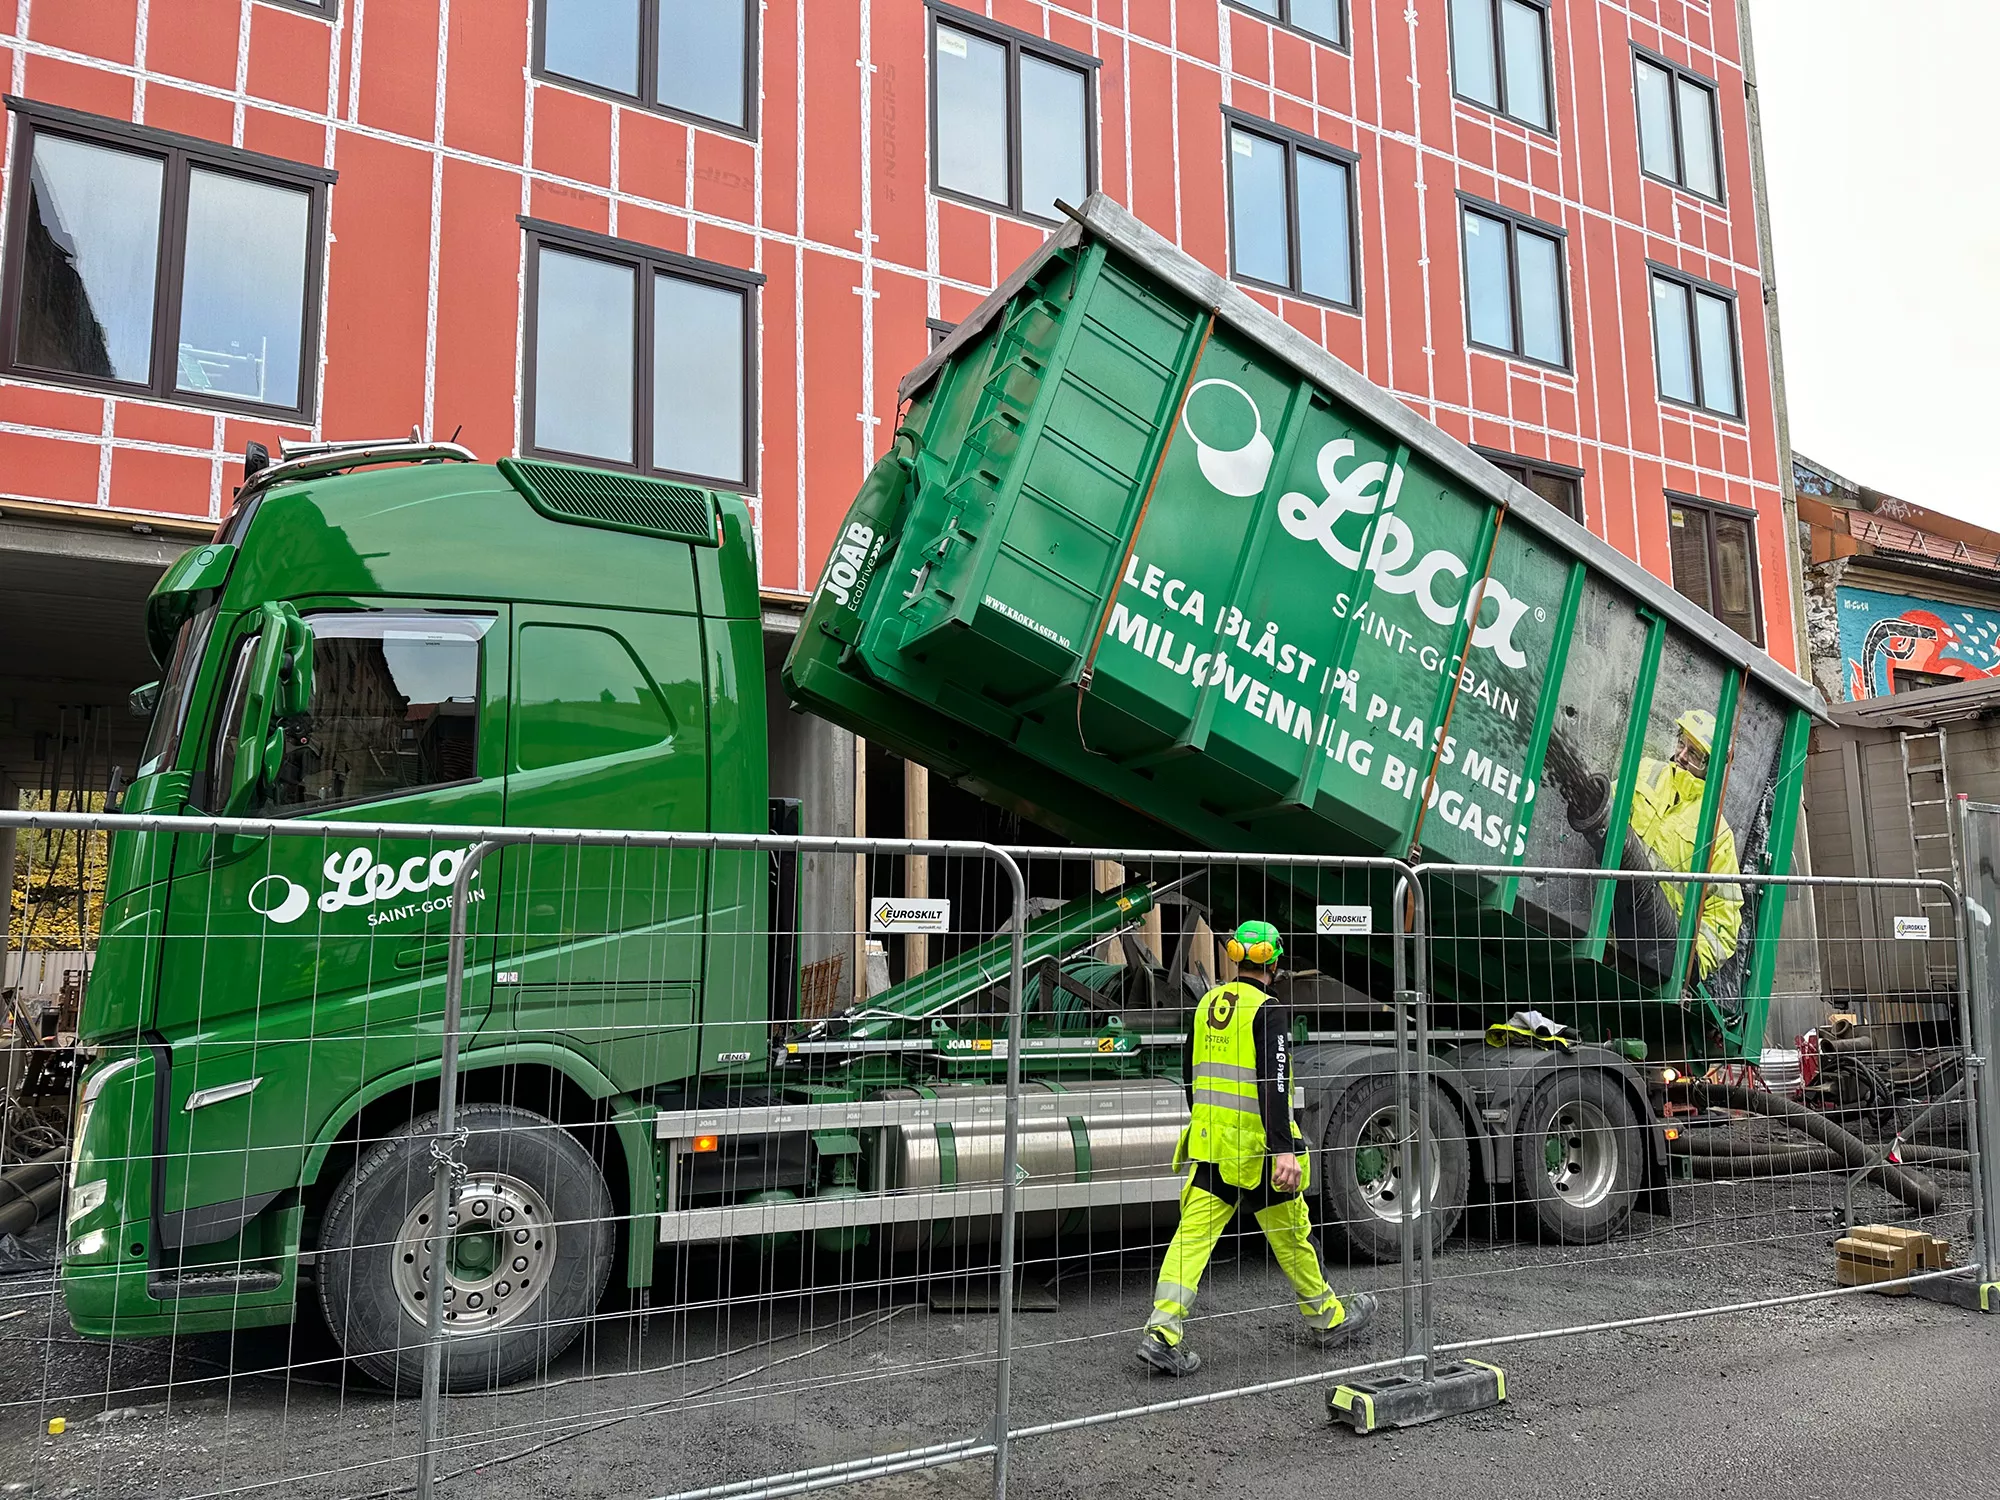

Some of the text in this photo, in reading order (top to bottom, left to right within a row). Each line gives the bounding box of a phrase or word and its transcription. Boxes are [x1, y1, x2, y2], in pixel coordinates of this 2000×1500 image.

[825, 522, 874, 605] JOAB
[848, 558, 876, 612] EcoDrive
[984, 594, 1071, 648] WWW.KROKKASSER.NO
[1123, 553, 1205, 626] LECA
[1214, 604, 1317, 684] BLÅST
[1320, 666, 1360, 713] PÅ
[1461, 748, 1536, 804] MED
[1332, 592, 1519, 721] SAINT-GOBAIN
[1106, 601, 1527, 857] MILJØVENNLIG BIOGASS
[367, 888, 486, 927] SAINT-GOBIN
[885, 910, 943, 919] EUROSKILT
[946, 1039, 973, 1050] JOAB
